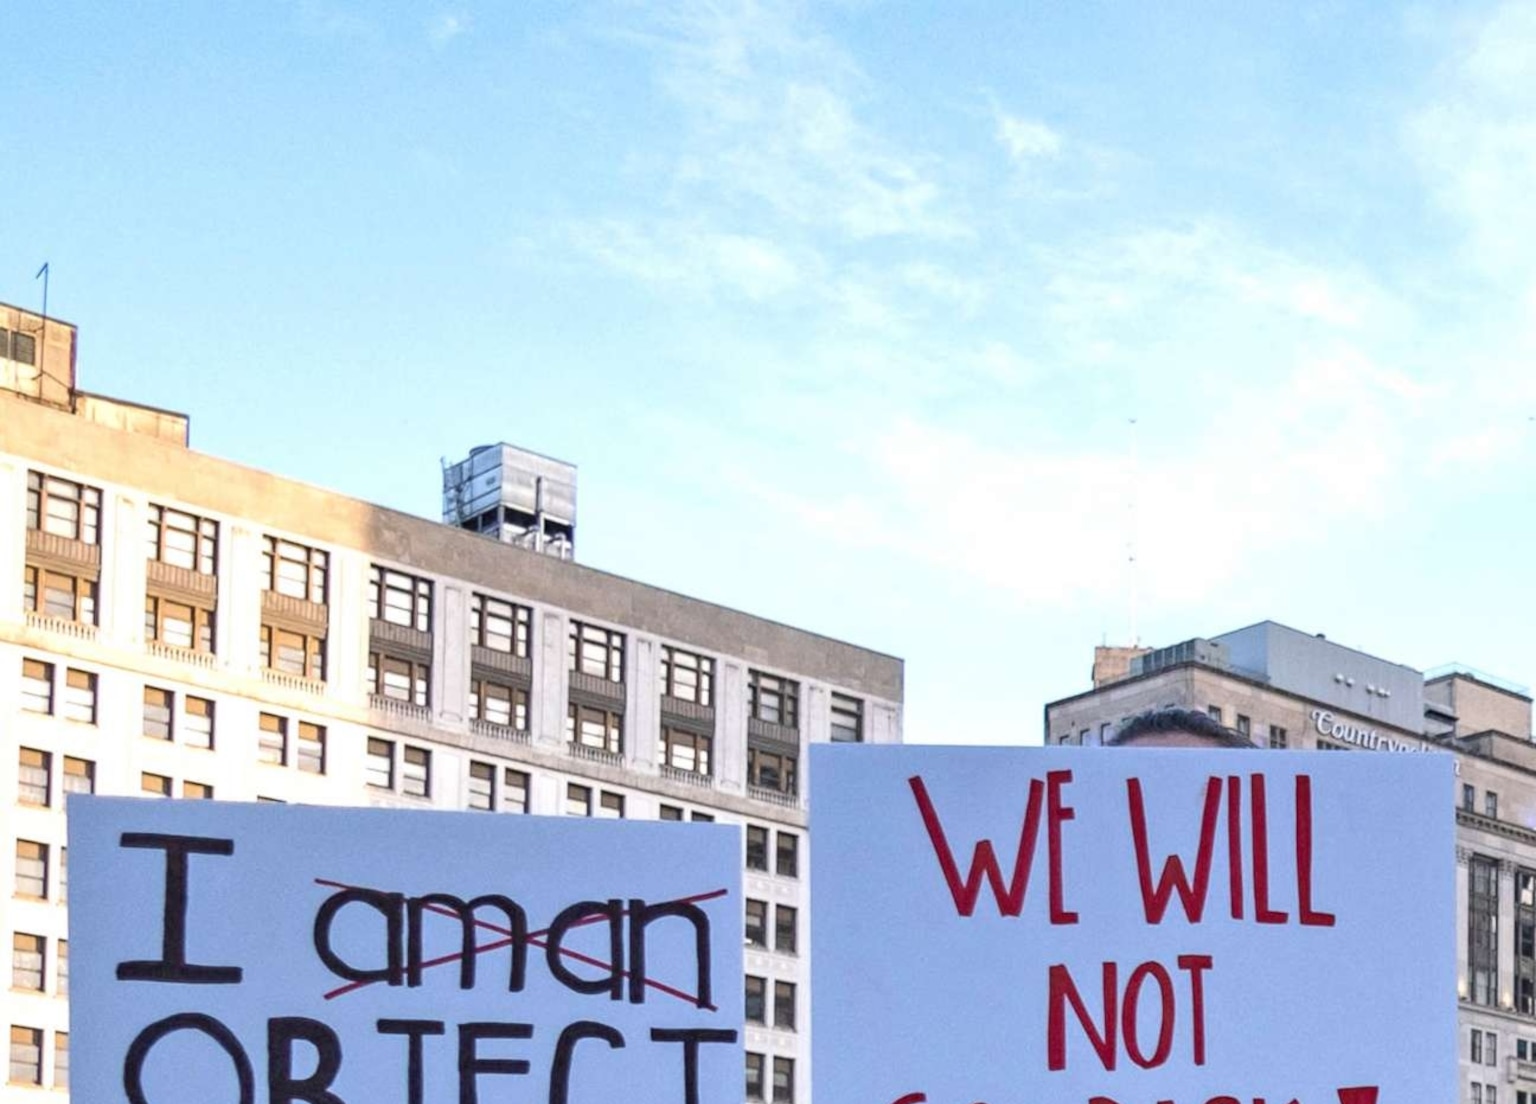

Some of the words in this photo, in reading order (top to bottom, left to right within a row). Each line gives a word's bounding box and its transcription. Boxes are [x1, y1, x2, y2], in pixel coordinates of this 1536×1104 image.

[115, 831, 243, 984] I
[908, 769, 1079, 925] WE
[1127, 773, 1336, 927] WILL
[1048, 955, 1213, 1072] NOT
